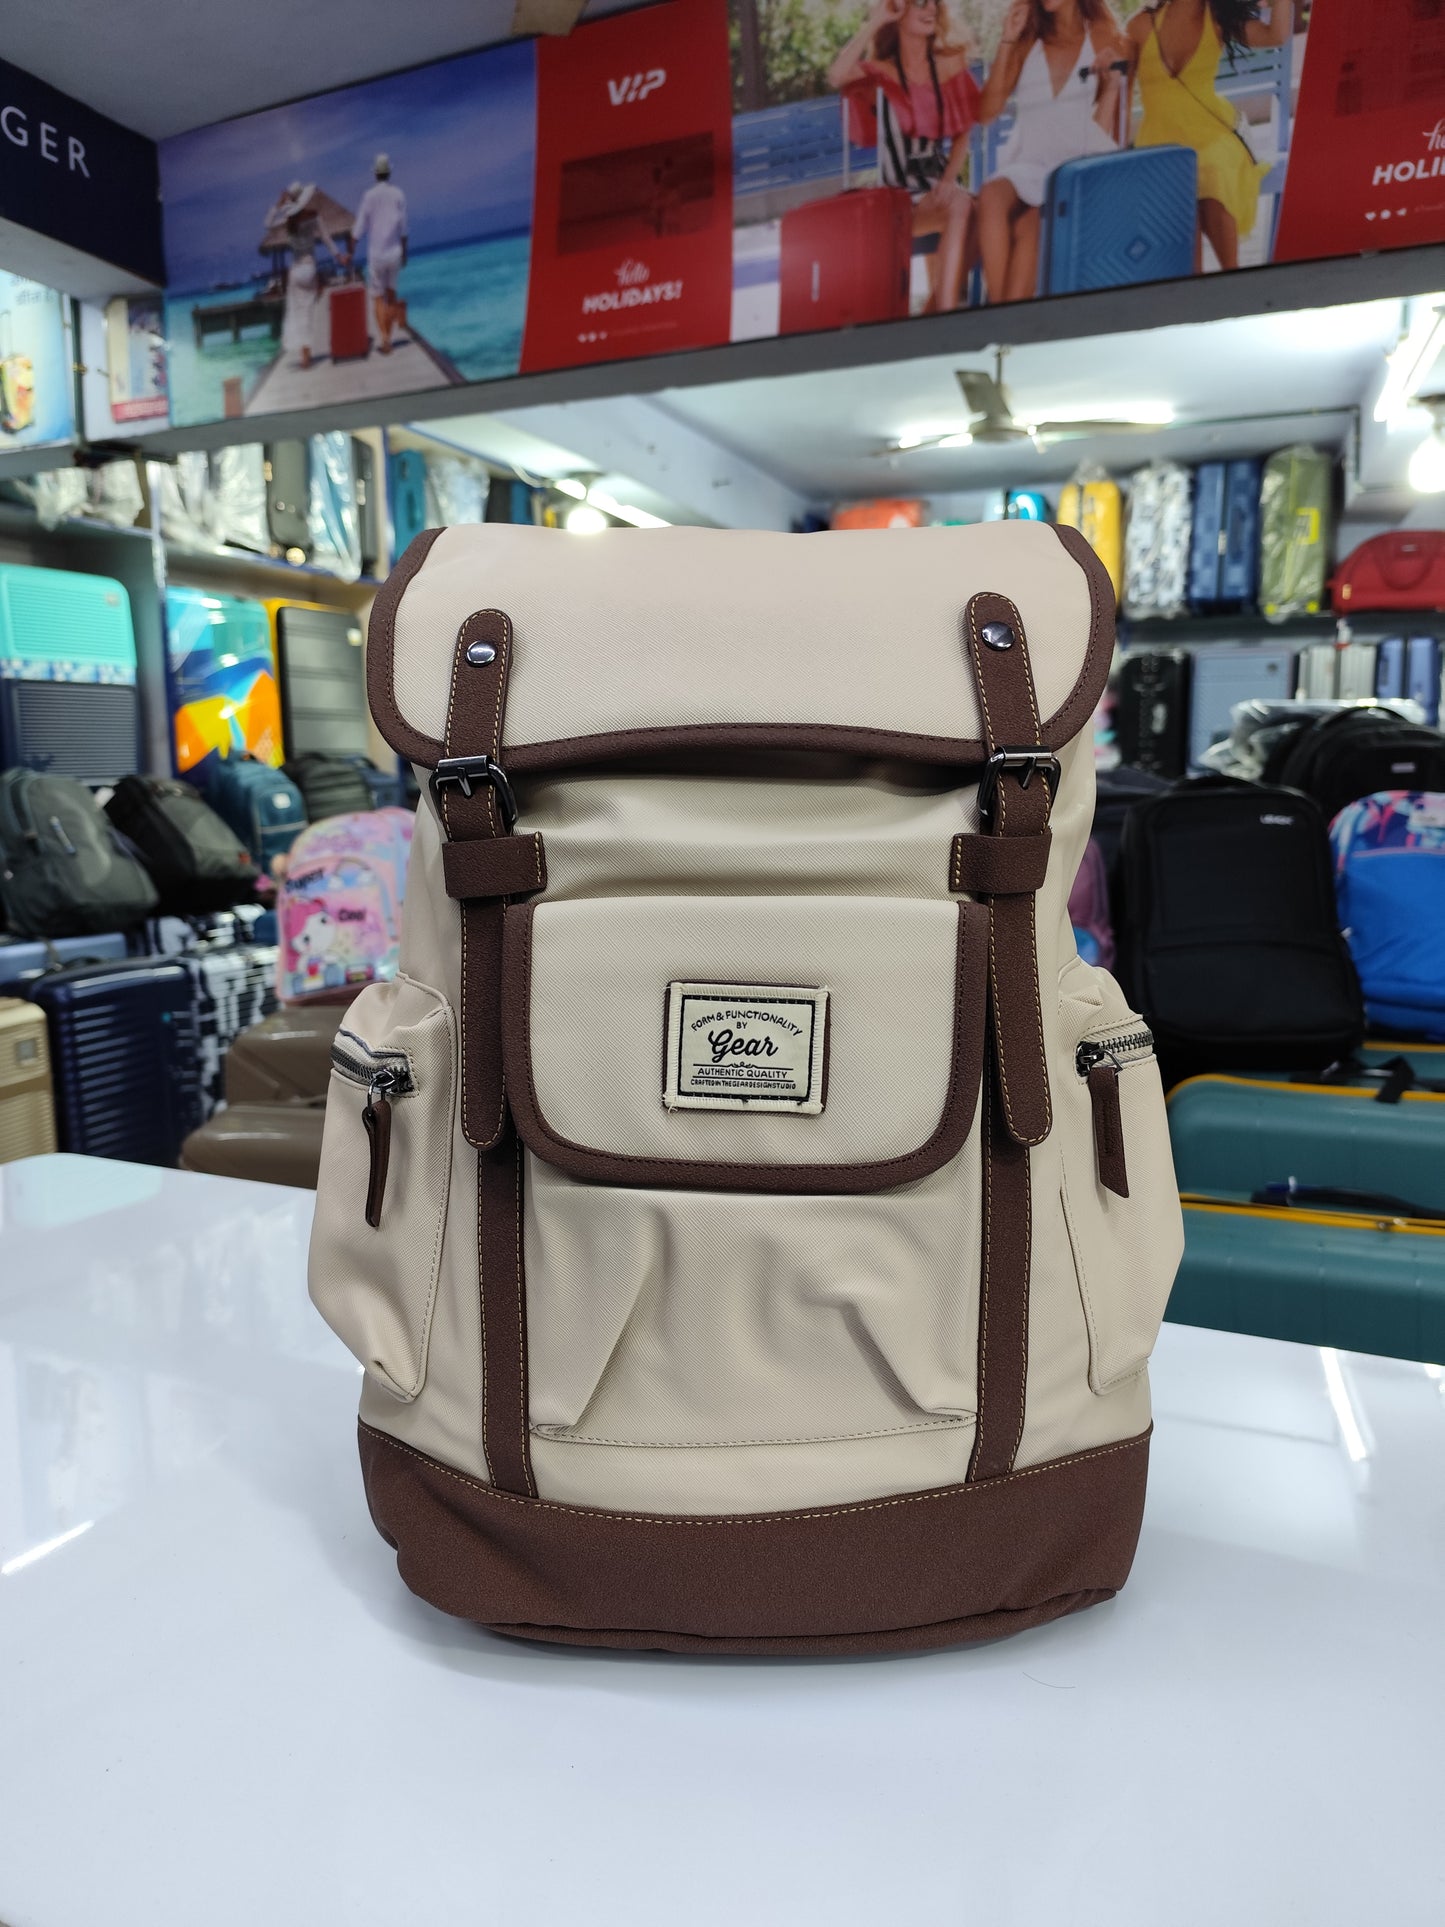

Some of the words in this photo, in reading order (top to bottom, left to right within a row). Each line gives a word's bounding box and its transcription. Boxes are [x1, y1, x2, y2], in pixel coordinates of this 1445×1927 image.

[607, 68, 666, 106] VIP
[0, 105, 91, 179] GER
[582, 279, 684, 315] HOLIDAYS!
[691, 1014, 715, 1031] FORM
[716, 1012, 725, 1021] &
[725, 1010, 803, 1037] FUNCTIONALITY
[736, 1021, 748, 1029] BY
[707, 1028, 779, 1063] Gear
[697, 1067, 744, 1077] AUTHENTIC
[746, 1069, 788, 1079] QUALITY
